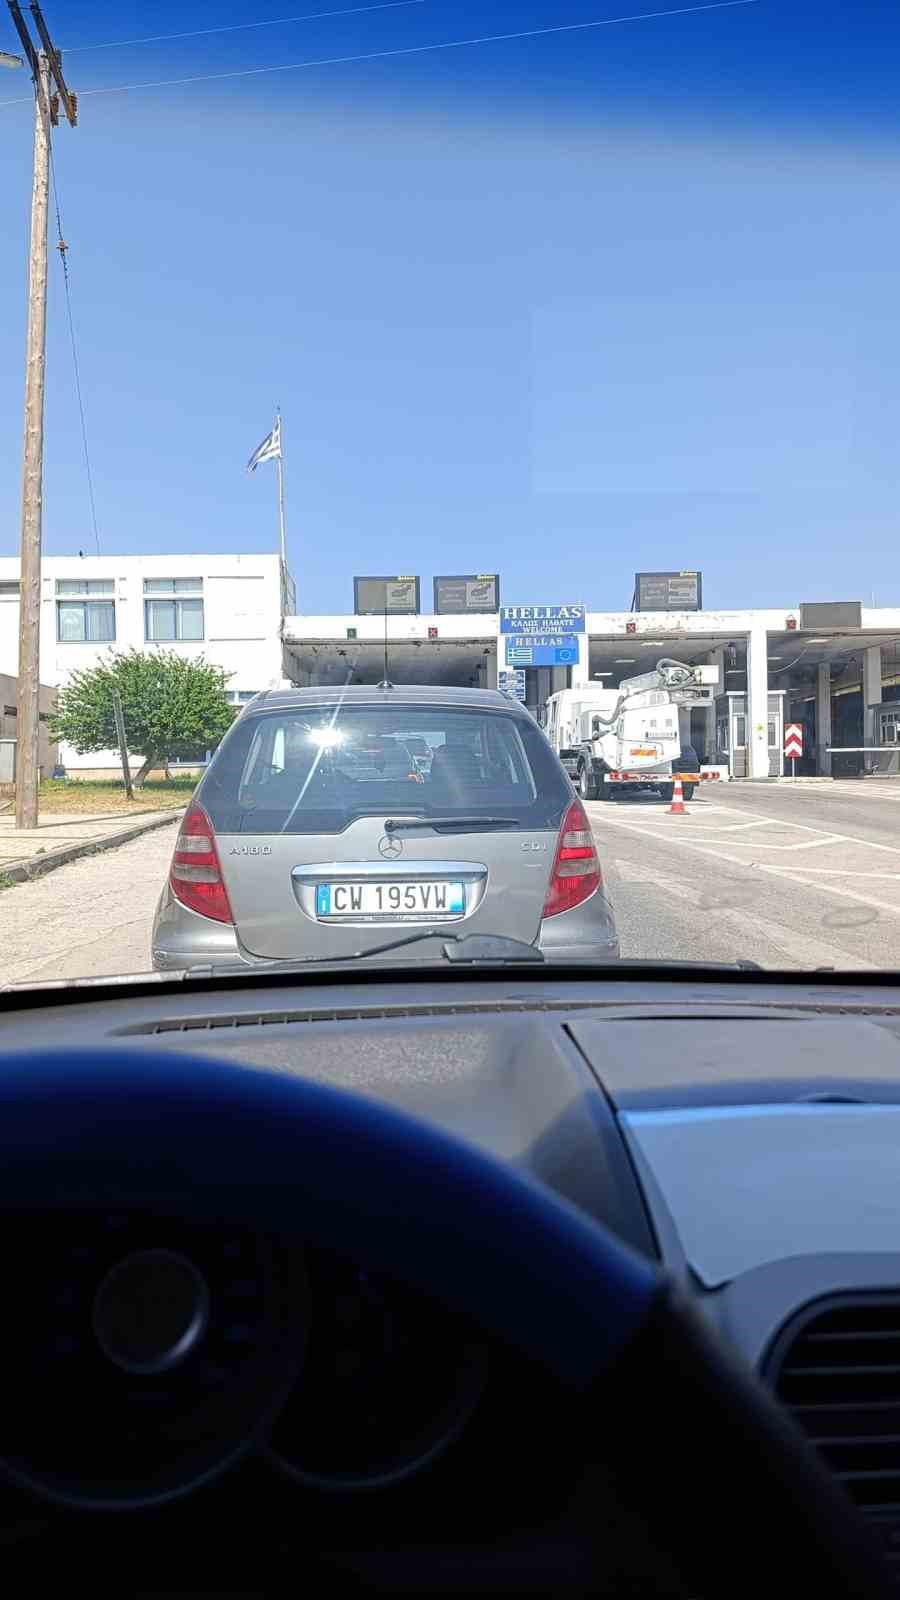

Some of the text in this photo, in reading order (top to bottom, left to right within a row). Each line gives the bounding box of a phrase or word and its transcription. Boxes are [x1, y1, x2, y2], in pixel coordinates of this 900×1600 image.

[504, 607, 582, 619] HELLAS
[515, 637, 563, 646] HELLAS
[334, 885, 447, 910] CW 195VW
